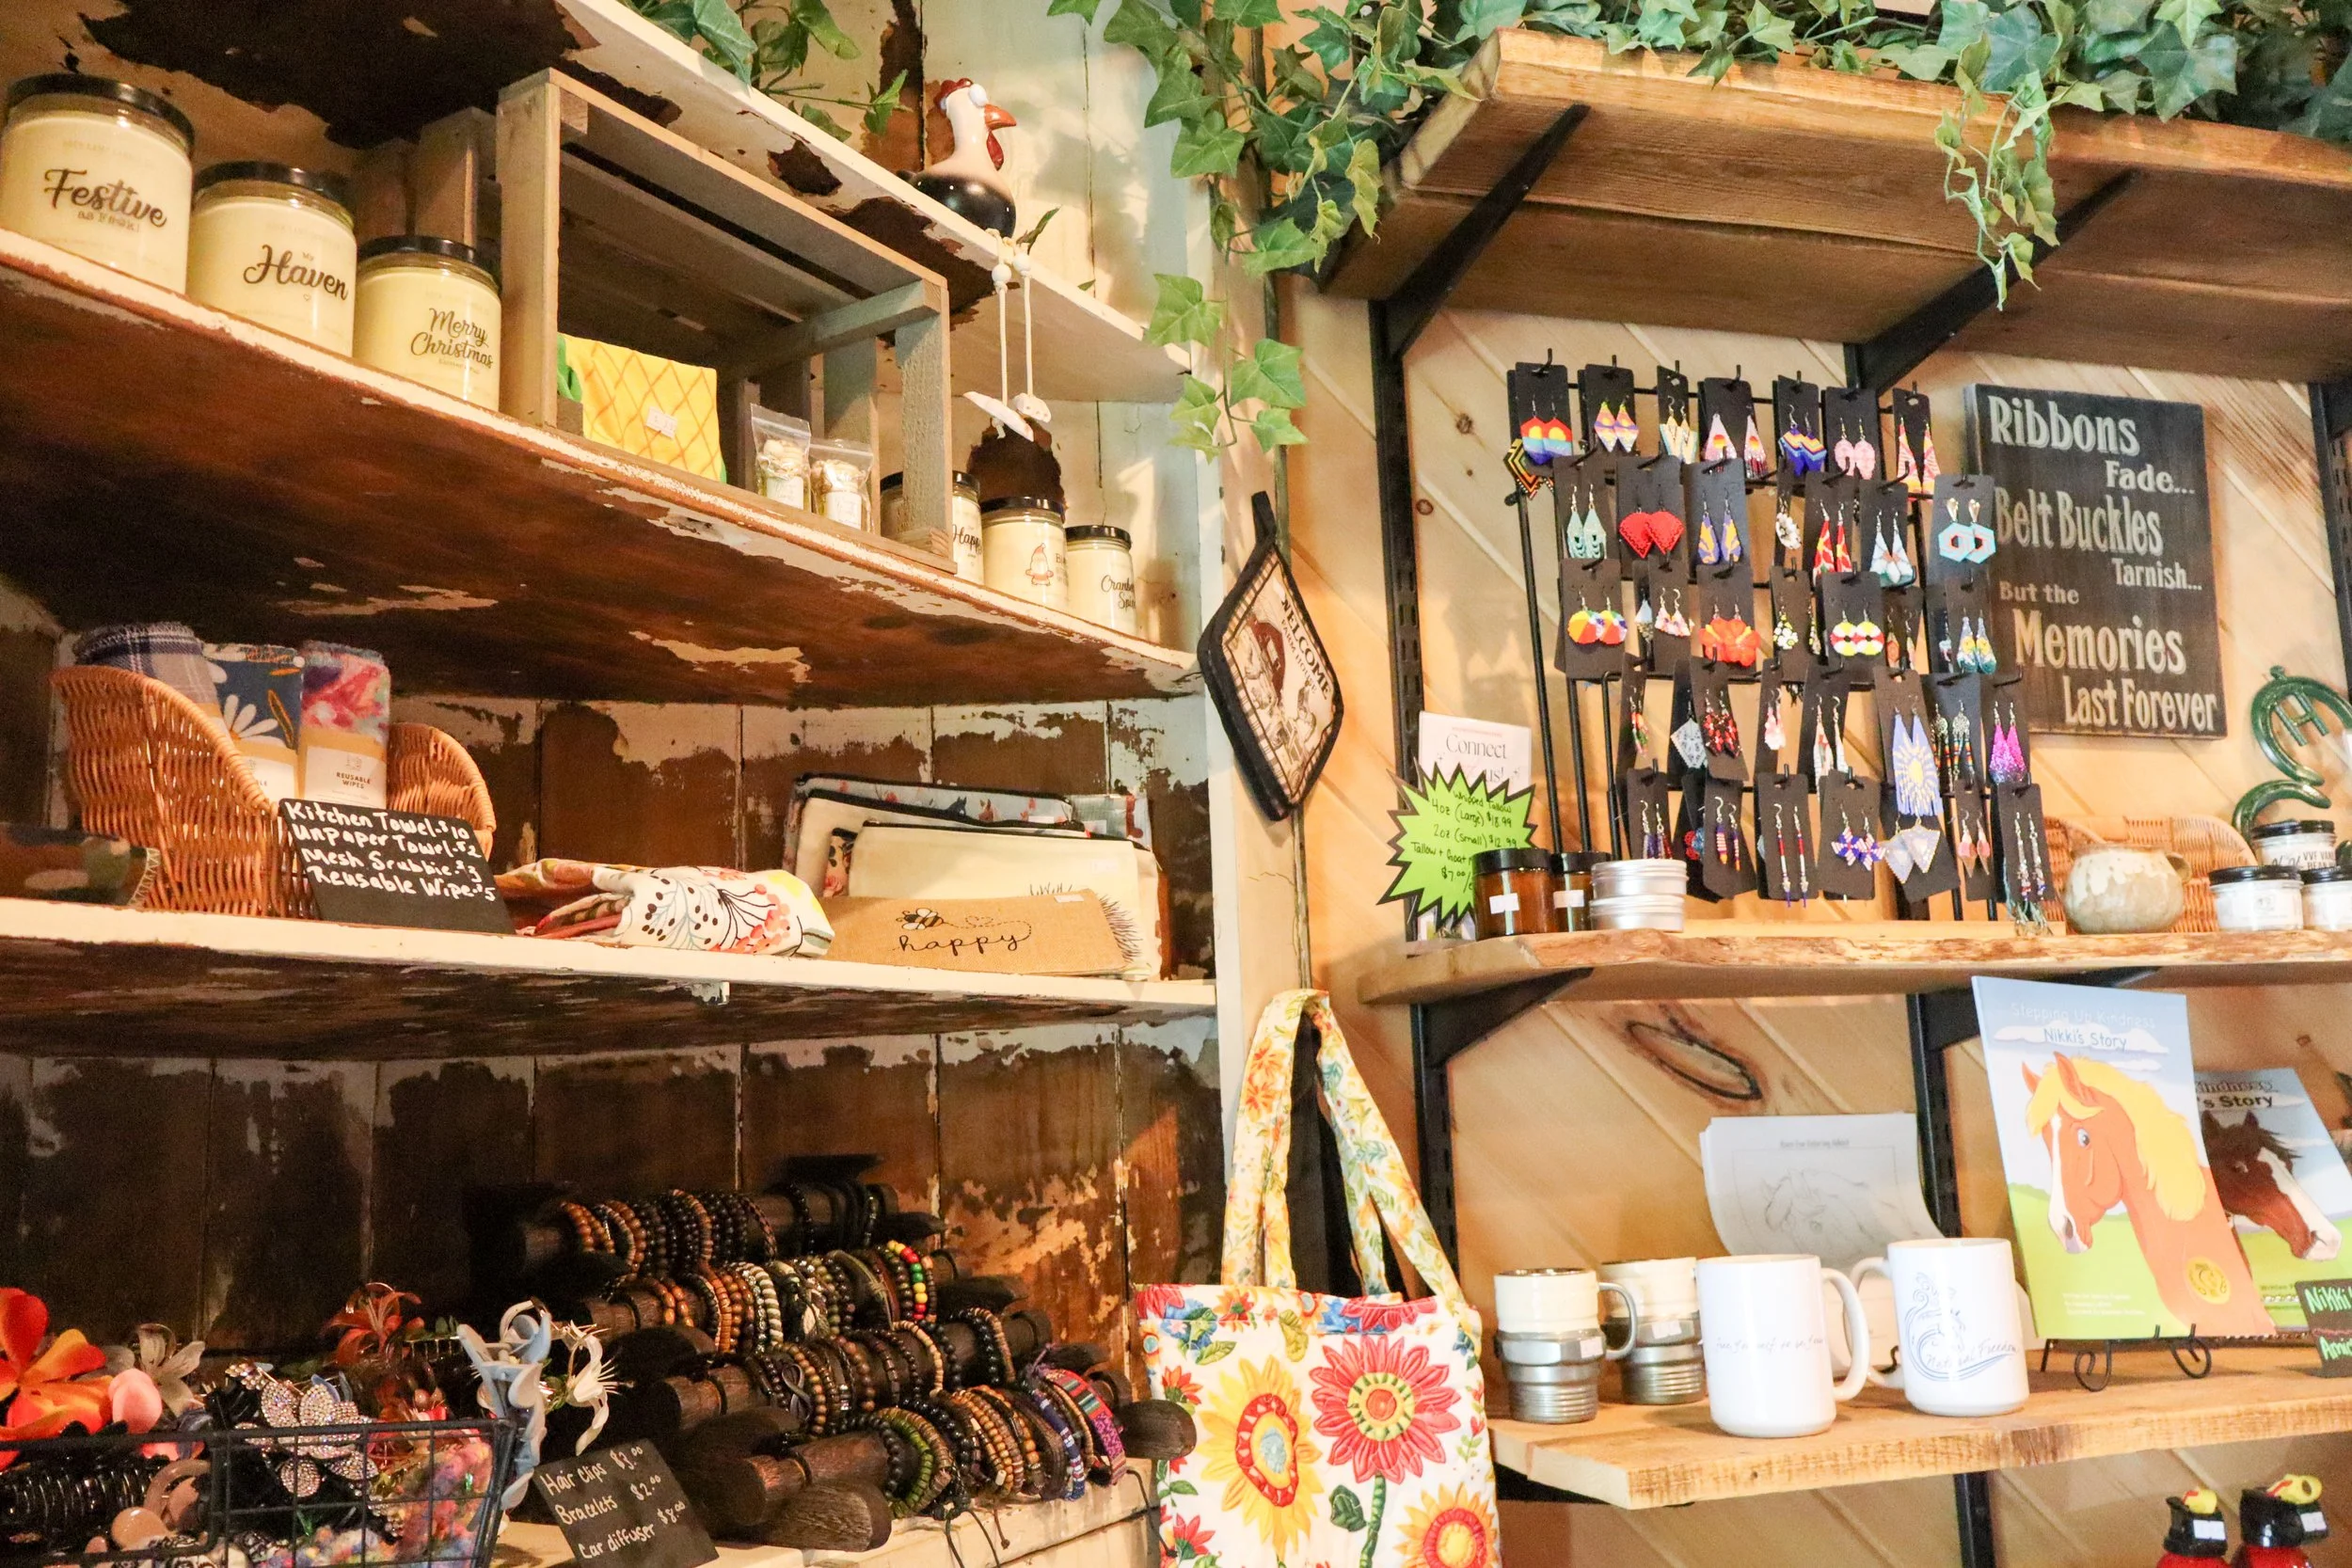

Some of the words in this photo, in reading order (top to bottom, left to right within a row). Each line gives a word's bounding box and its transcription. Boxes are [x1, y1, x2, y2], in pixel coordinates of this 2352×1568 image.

[43, 167, 167, 228] Festive
[243, 244, 349, 301] Haven
[428, 307, 489, 348] Merry
[410, 331, 494, 369] Christmas
[1987, 394, 2140, 457] Ribbons
[2105, 459, 2196, 495] Fade...
[1994, 485, 2055, 549] Belt
[2056, 489, 2164, 557] Buckles
[2110, 557, 2202, 591] Tarnish...
[1998, 580, 2040, 603] But
[2042, 583, 2080, 606] the
[2012, 608, 2187, 675] Memories
[2062, 674, 2119, 728] Last
[2122, 677, 2217, 733] Forever
[1445, 734, 1508, 760] Connect
[336, 771, 372, 785] REUSABLE
[342, 779, 365, 790] WIPES
[284, 801, 373, 829] Kitchen
[1454, 802, 1486, 828] (Large)
[292, 823, 390, 848] Unpaper
[1411, 840, 1438, 857] Tallow
[300, 847, 365, 868] Mesh
[306, 864, 417, 895] Reusable
[898, 934, 1018, 957] happy
[2010, 1001, 2069, 1023] Stepping
[2074, 1008, 2091, 1024] Up
[2096, 1008, 2156, 1030] Kindness
[2043, 1027, 2085, 1045] Nikki's
[2090, 1032, 2128, 1053] Story
[2218, 1095, 2273, 1109] Story
[539, 1469, 577, 1497] Hair
[554, 1494, 619, 1526] Bracelets
[578, 1541, 604, 1560] Car
[606, 1523, 657, 1553] diffuser
